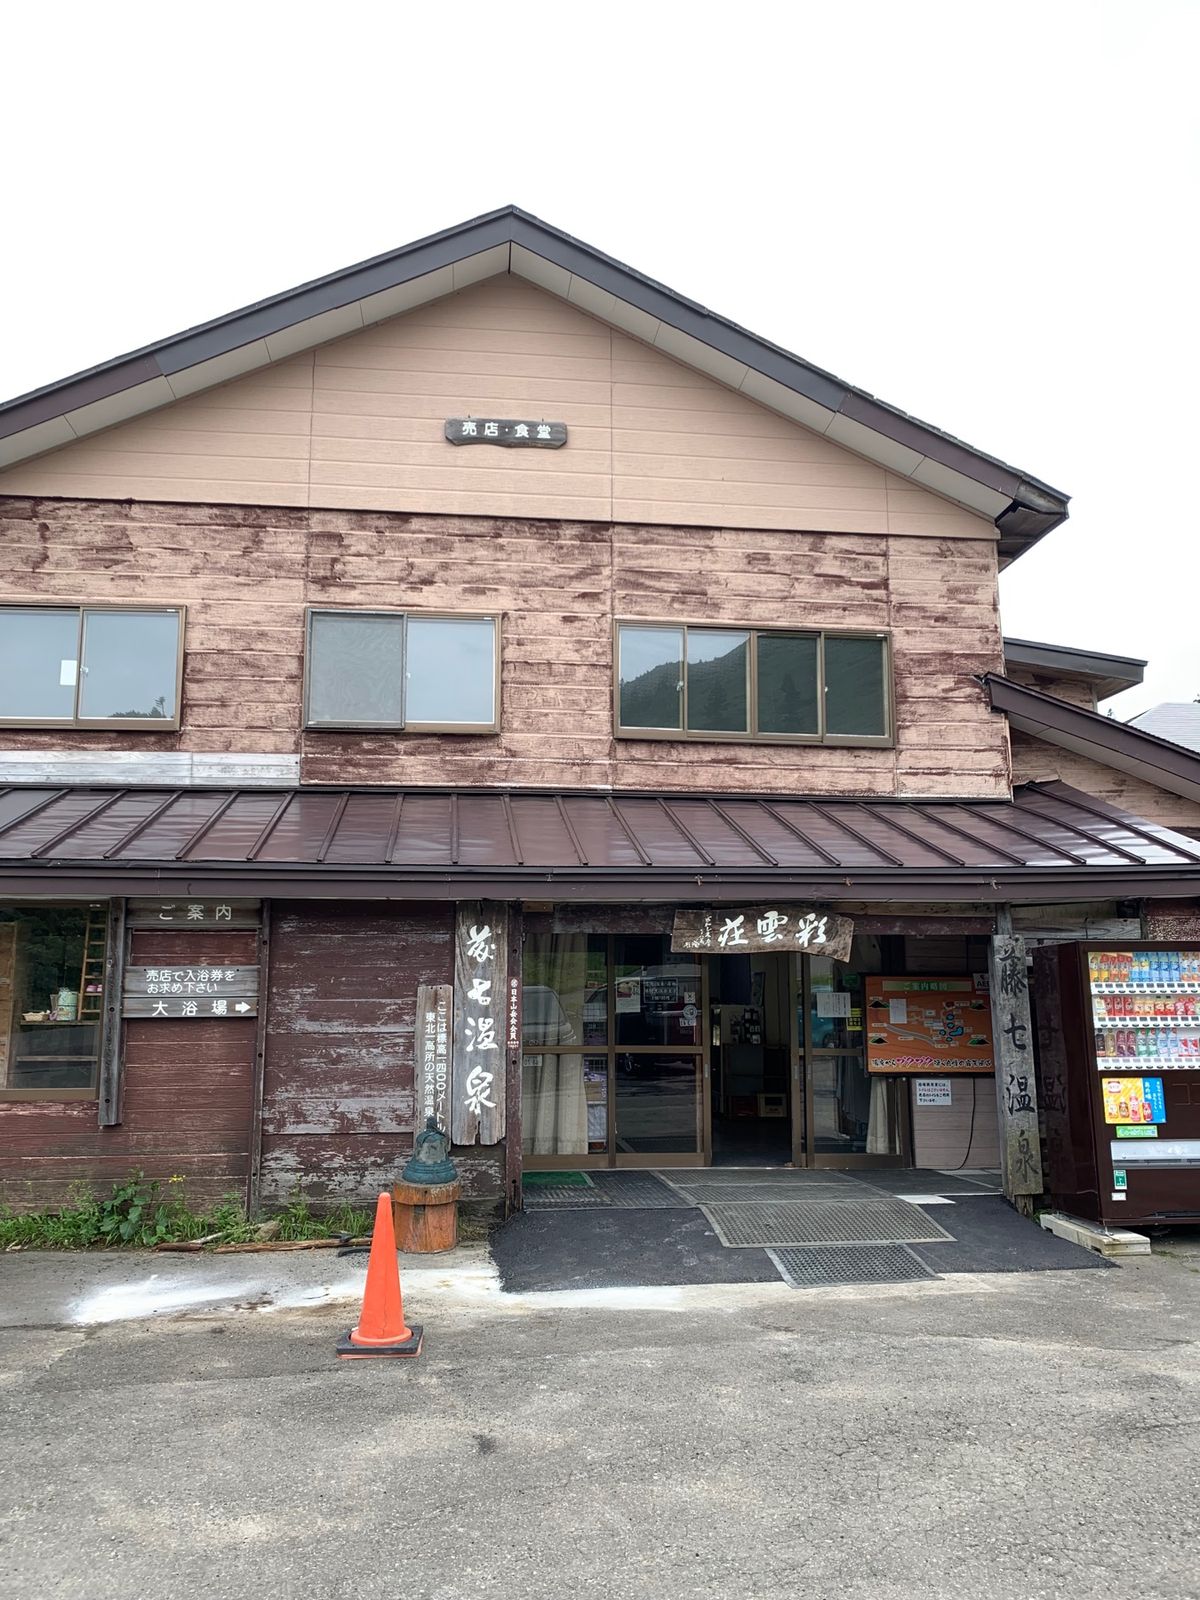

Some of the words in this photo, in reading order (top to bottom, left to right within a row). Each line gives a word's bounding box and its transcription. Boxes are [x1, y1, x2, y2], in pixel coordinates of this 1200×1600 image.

[462, 421, 551, 439] 売店・食堂
[159, 904, 232, 920] ご案内
[146, 969, 236, 982] 売店で入浴券を
[147, 982, 218, 994] お求め下さい
[152, 1000, 228, 1016] 大浴場
[999, 943, 1040, 1184] 藤七温泉
[424, 1011, 436, 1133] 東北一高所の天然温泉
